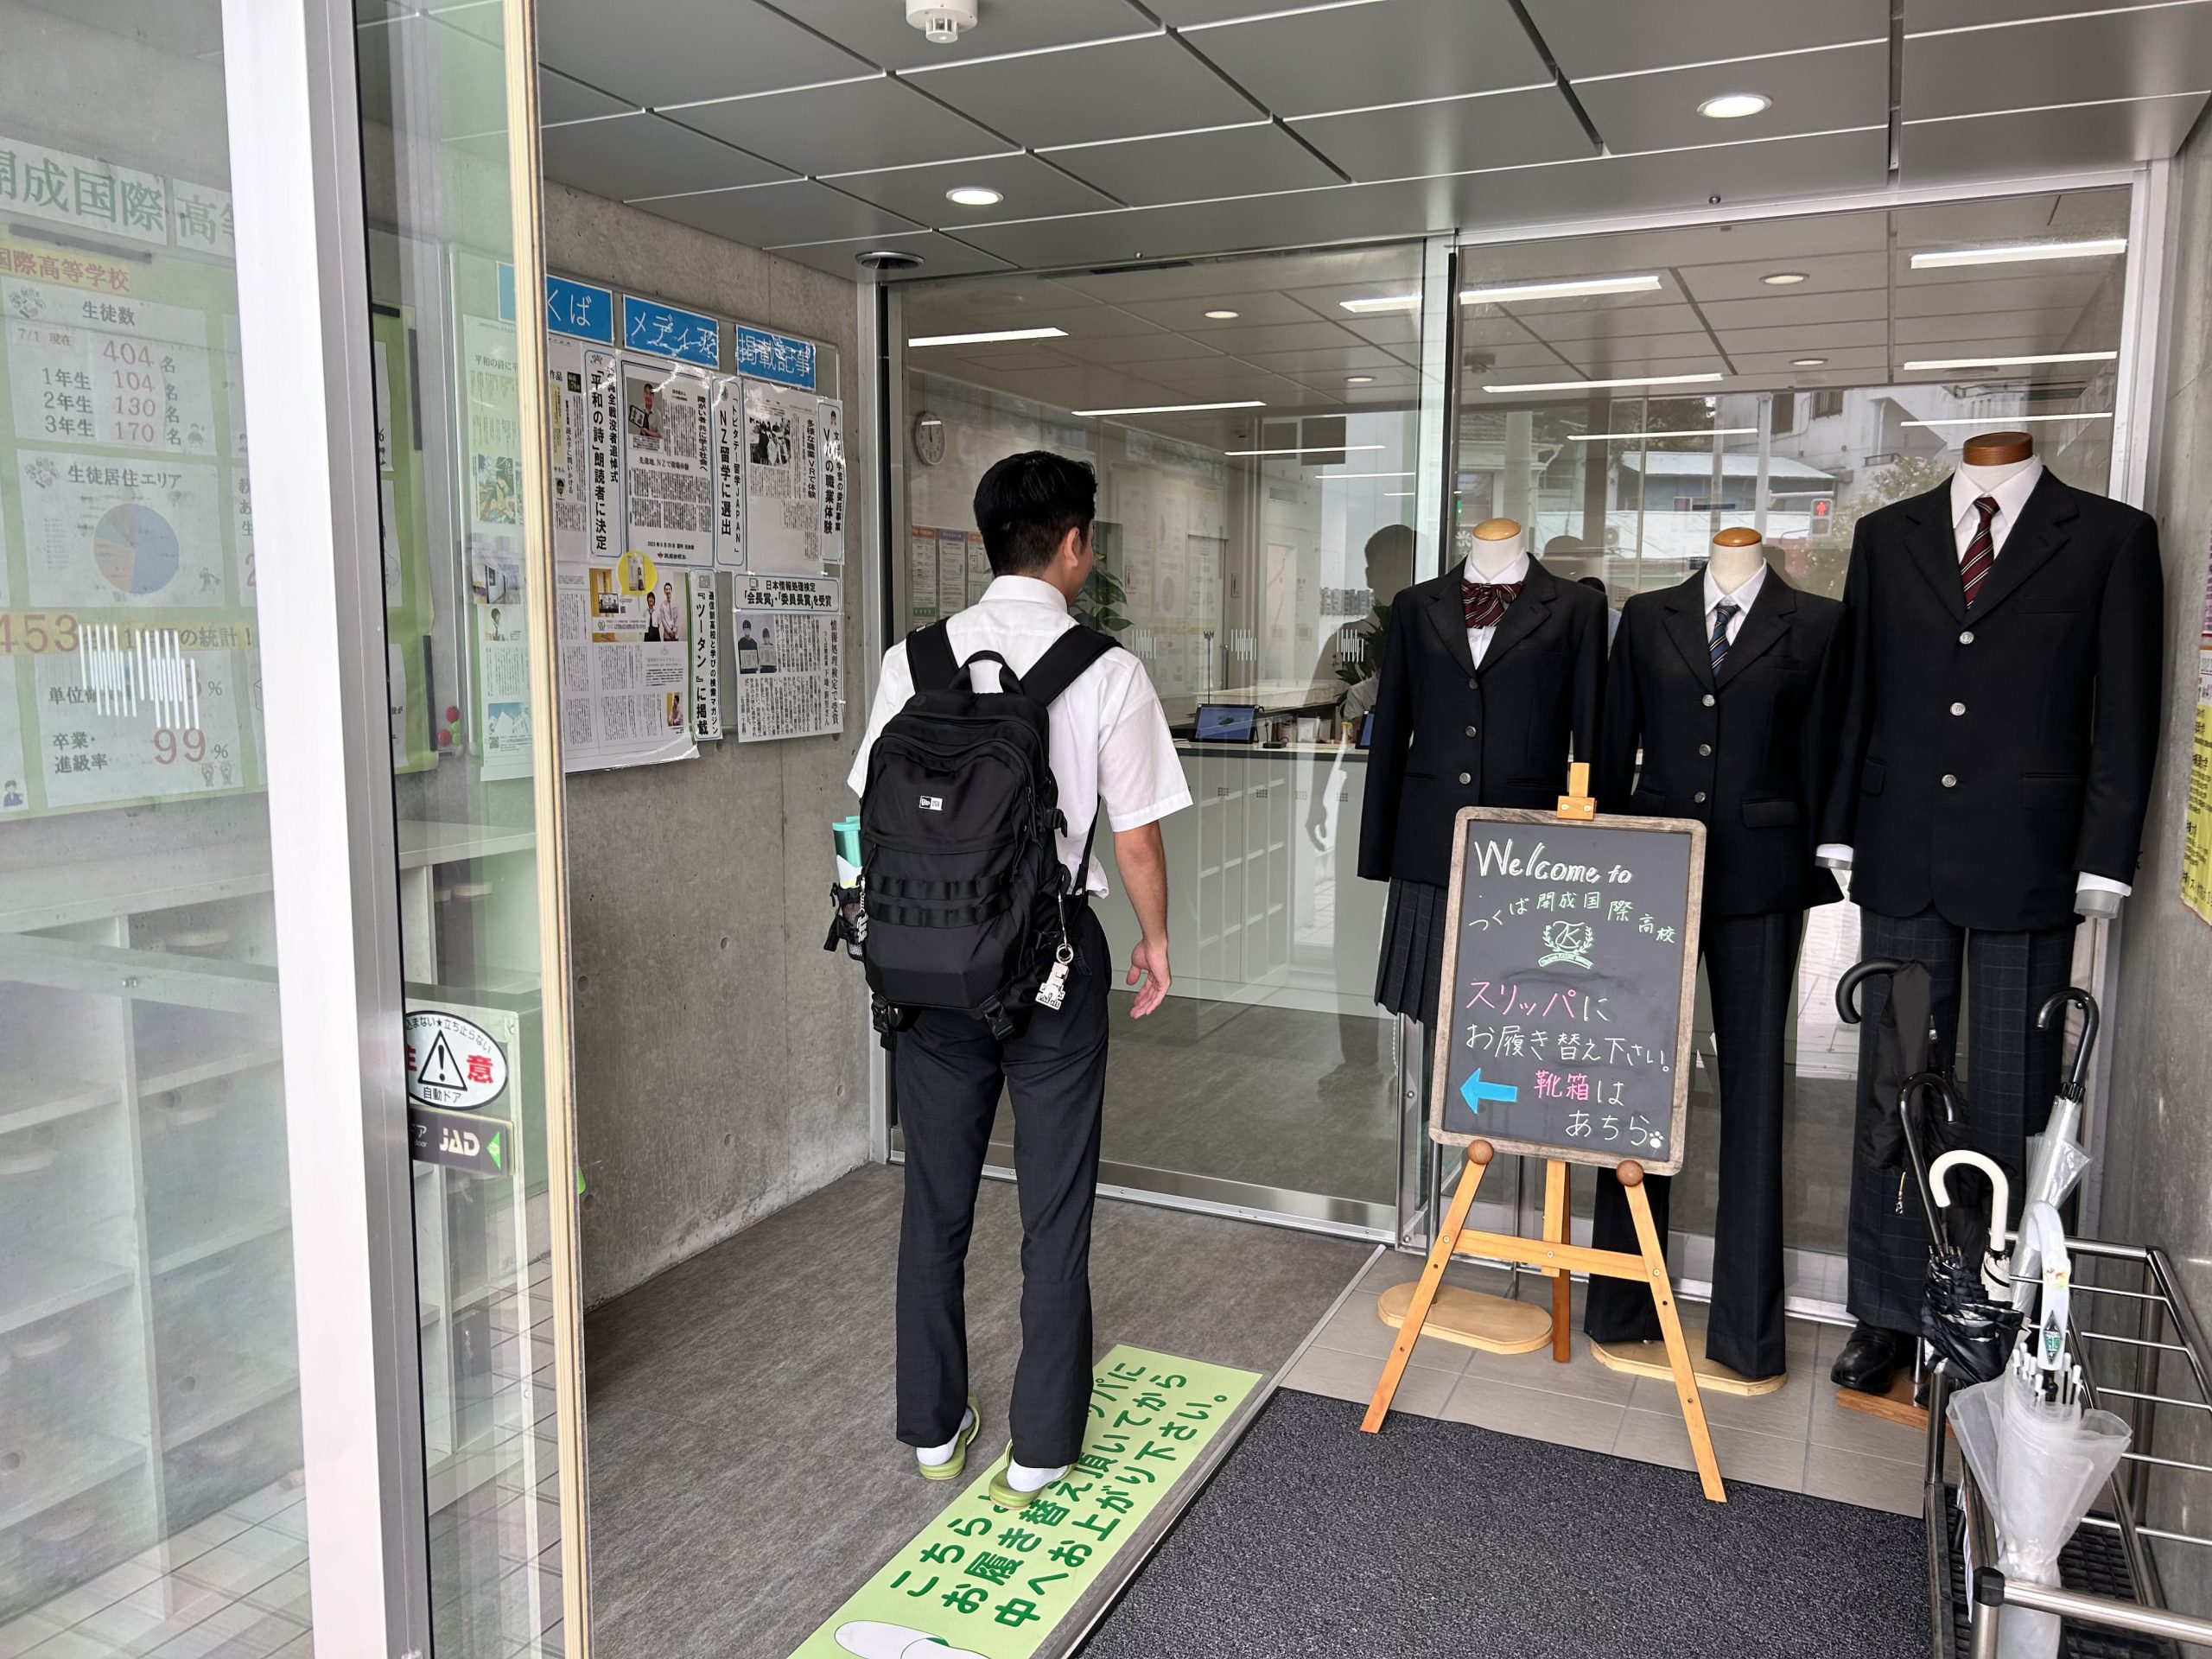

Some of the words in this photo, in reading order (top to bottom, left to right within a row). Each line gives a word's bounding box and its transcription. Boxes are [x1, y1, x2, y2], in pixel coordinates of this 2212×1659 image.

[82, 301, 136, 327] 生徒数
[631, 311, 715, 353] メディア
[103, 340, 154, 368] 404
[161, 355, 176, 374] 名
[738, 333, 810, 377] 掲載記事
[41, 367, 92, 391] 1年生
[114, 370, 154, 393] 104
[164, 384, 178, 402] 名
[43, 391, 93, 415] 2年生
[115, 395, 156, 417] 130
[165, 405, 181, 423] 名
[45, 415, 95, 438] 3年生
[115, 421, 155, 443] 170
[166, 428, 182, 446] 名
[67, 464, 182, 489] 生徒居住エリア
[766, 581, 816, 593] 日本情報処理検定
[54, 753, 109, 774] 進級率
[153, 728, 207, 765] 99
[1474, 838, 1599, 883] Welcome
[1607, 864, 1631, 883] to
[1468, 891, 1678, 944] つくば開成国際高校
[1465, 981, 1611, 1021] スリッパに
[1466, 1024, 1670, 1072] お履き替え下さい。
[423, 1086, 461, 1103] 自動ドア
[1534, 1070, 1625, 1107] 靴箱は
[994, 1394, 1228, 1628] 中へお上がり下さい。
